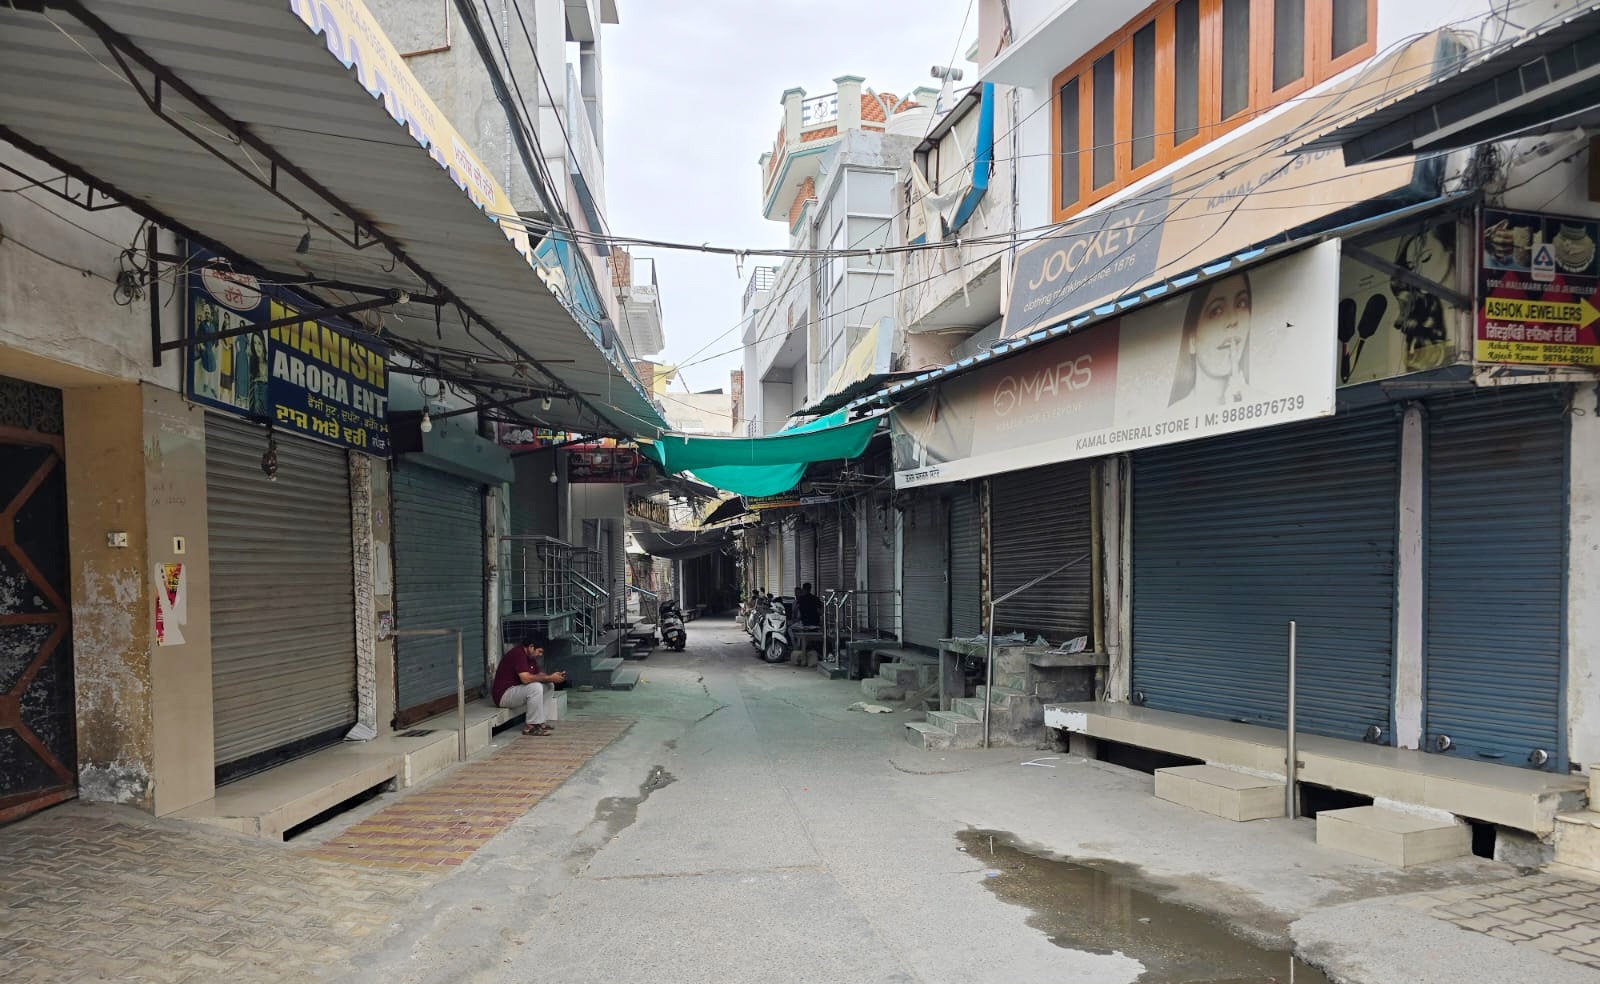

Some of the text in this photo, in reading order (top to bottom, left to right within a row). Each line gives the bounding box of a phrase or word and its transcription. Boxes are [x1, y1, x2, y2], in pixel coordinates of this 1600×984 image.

[1206, 181, 1255, 211] KAMAL
[1258, 166, 1290, 186] GEN
[1029, 209, 1145, 290] JOCKEY
[1023, 254, 1136, 313] clothing mankind since 1876
[1487, 302, 1582, 321] ASHOK JEWELLERS
[270, 297, 385, 389] MANISH
[273, 350, 388, 418] ARORA ENT
[1018, 354, 1092, 407] MARS
[312, 416, 340, 439] ਅਤੇ
[1075, 436, 1107, 451] KAMAL
[1109, 425, 1152, 444] GENERAL
[1155, 418, 1189, 436] STORE
[1205, 413, 1219, 428] M:
[1222, 394, 1305, 424] 9888876739
